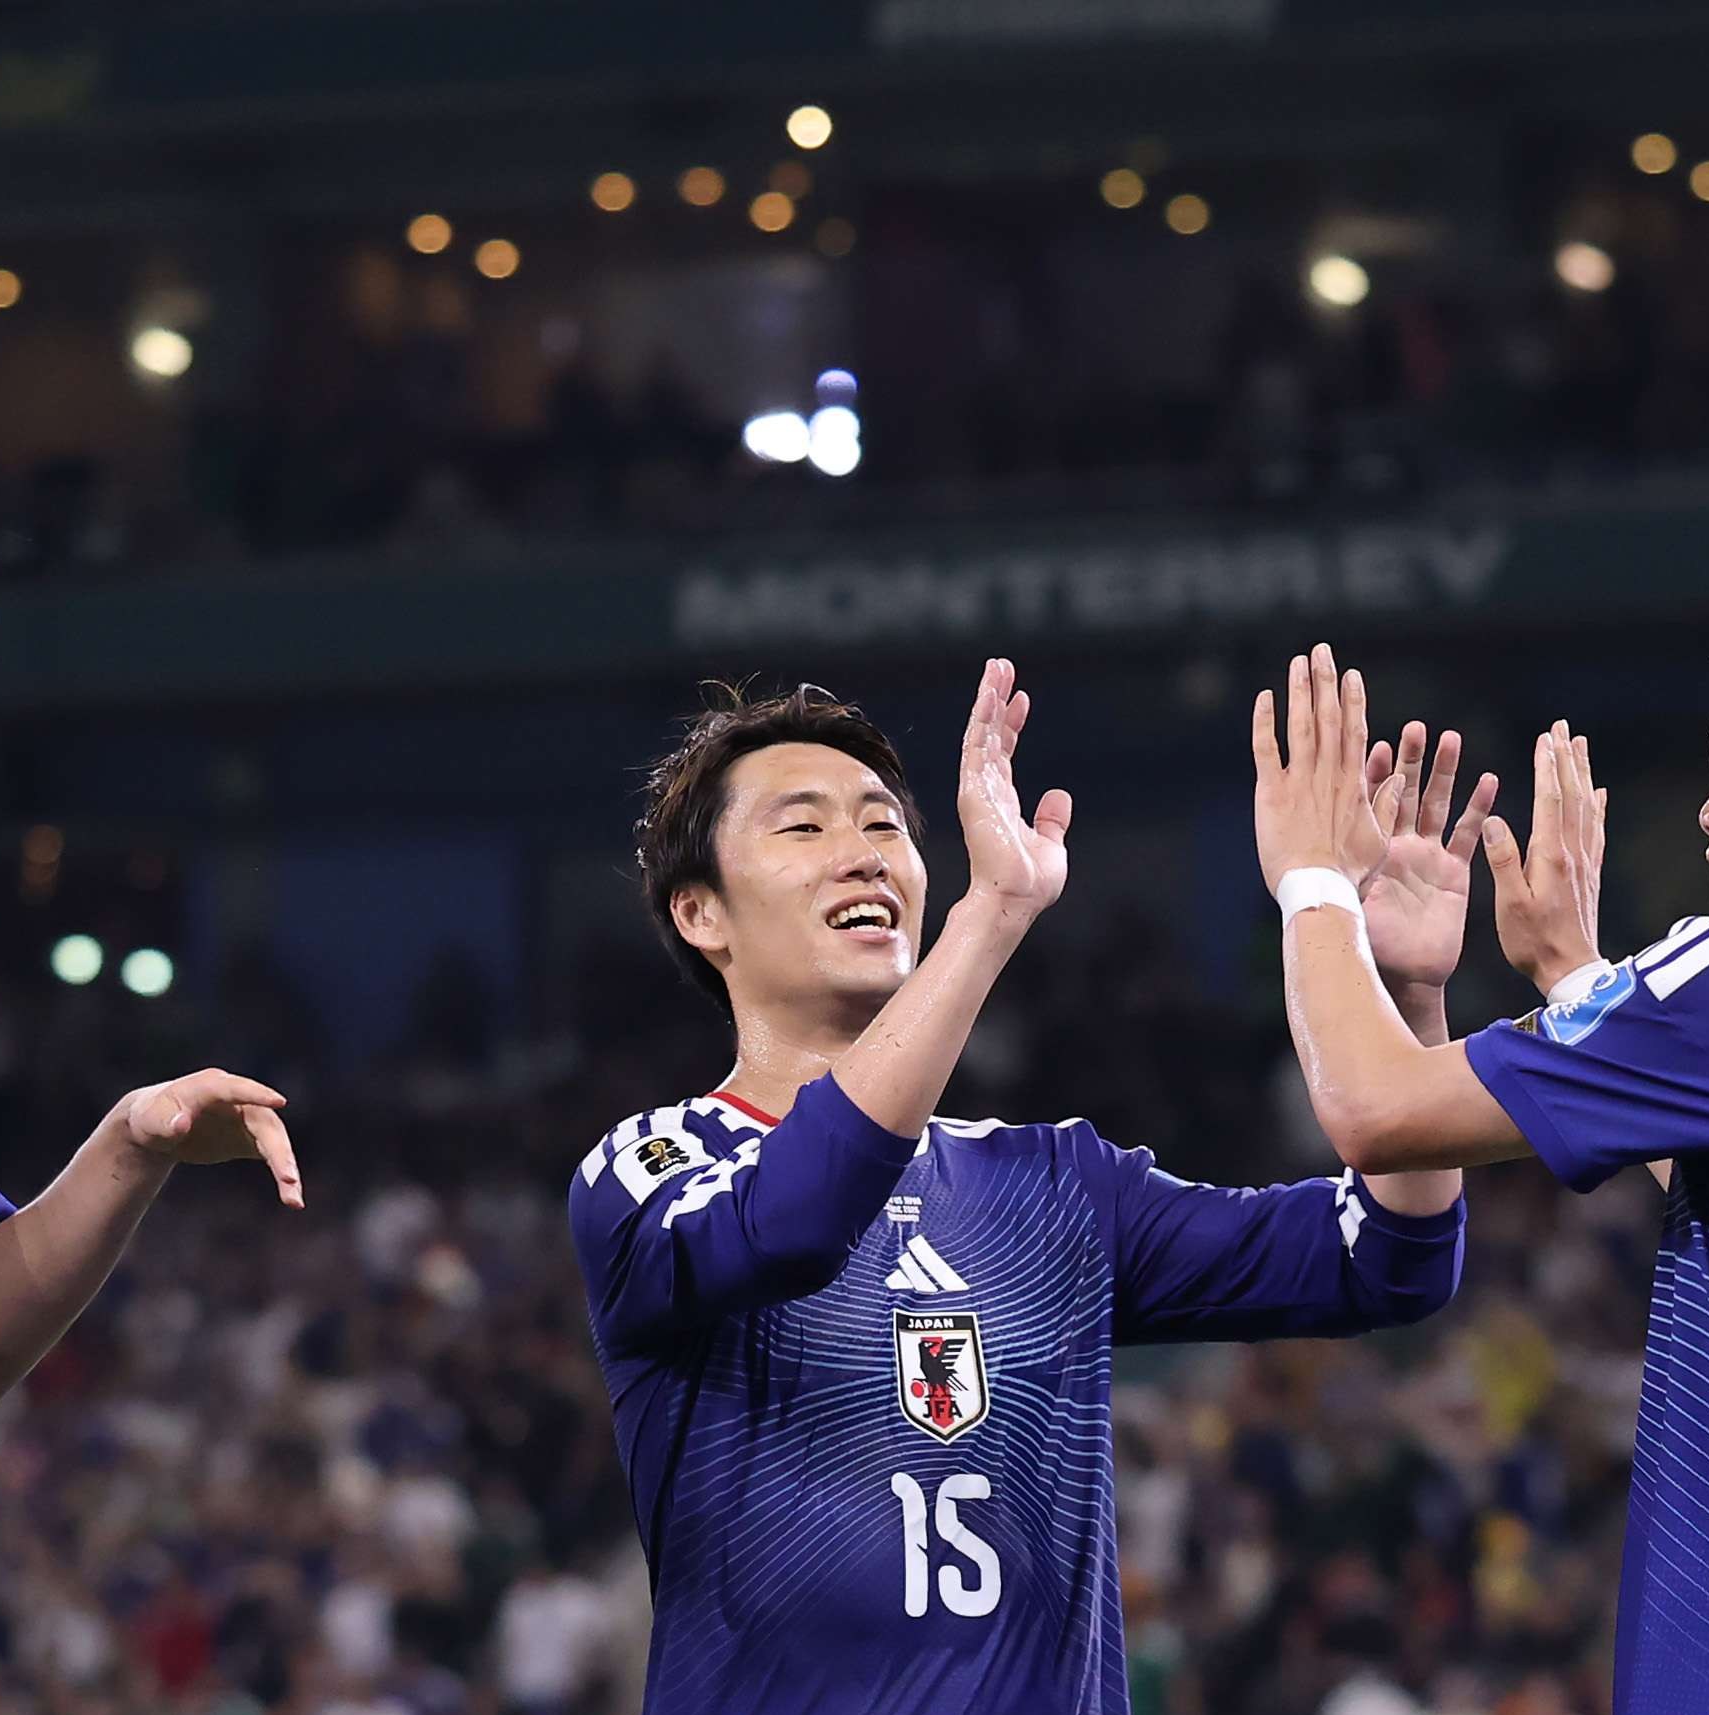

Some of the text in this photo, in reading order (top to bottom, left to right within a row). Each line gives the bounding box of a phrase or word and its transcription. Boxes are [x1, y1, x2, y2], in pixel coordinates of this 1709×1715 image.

[672, 525, 1515, 643] MONTERREY
[907, 1318, 955, 1329] JAPAN
[922, 1400, 963, 1419] JFA
[891, 1472, 1002, 1617] 15
